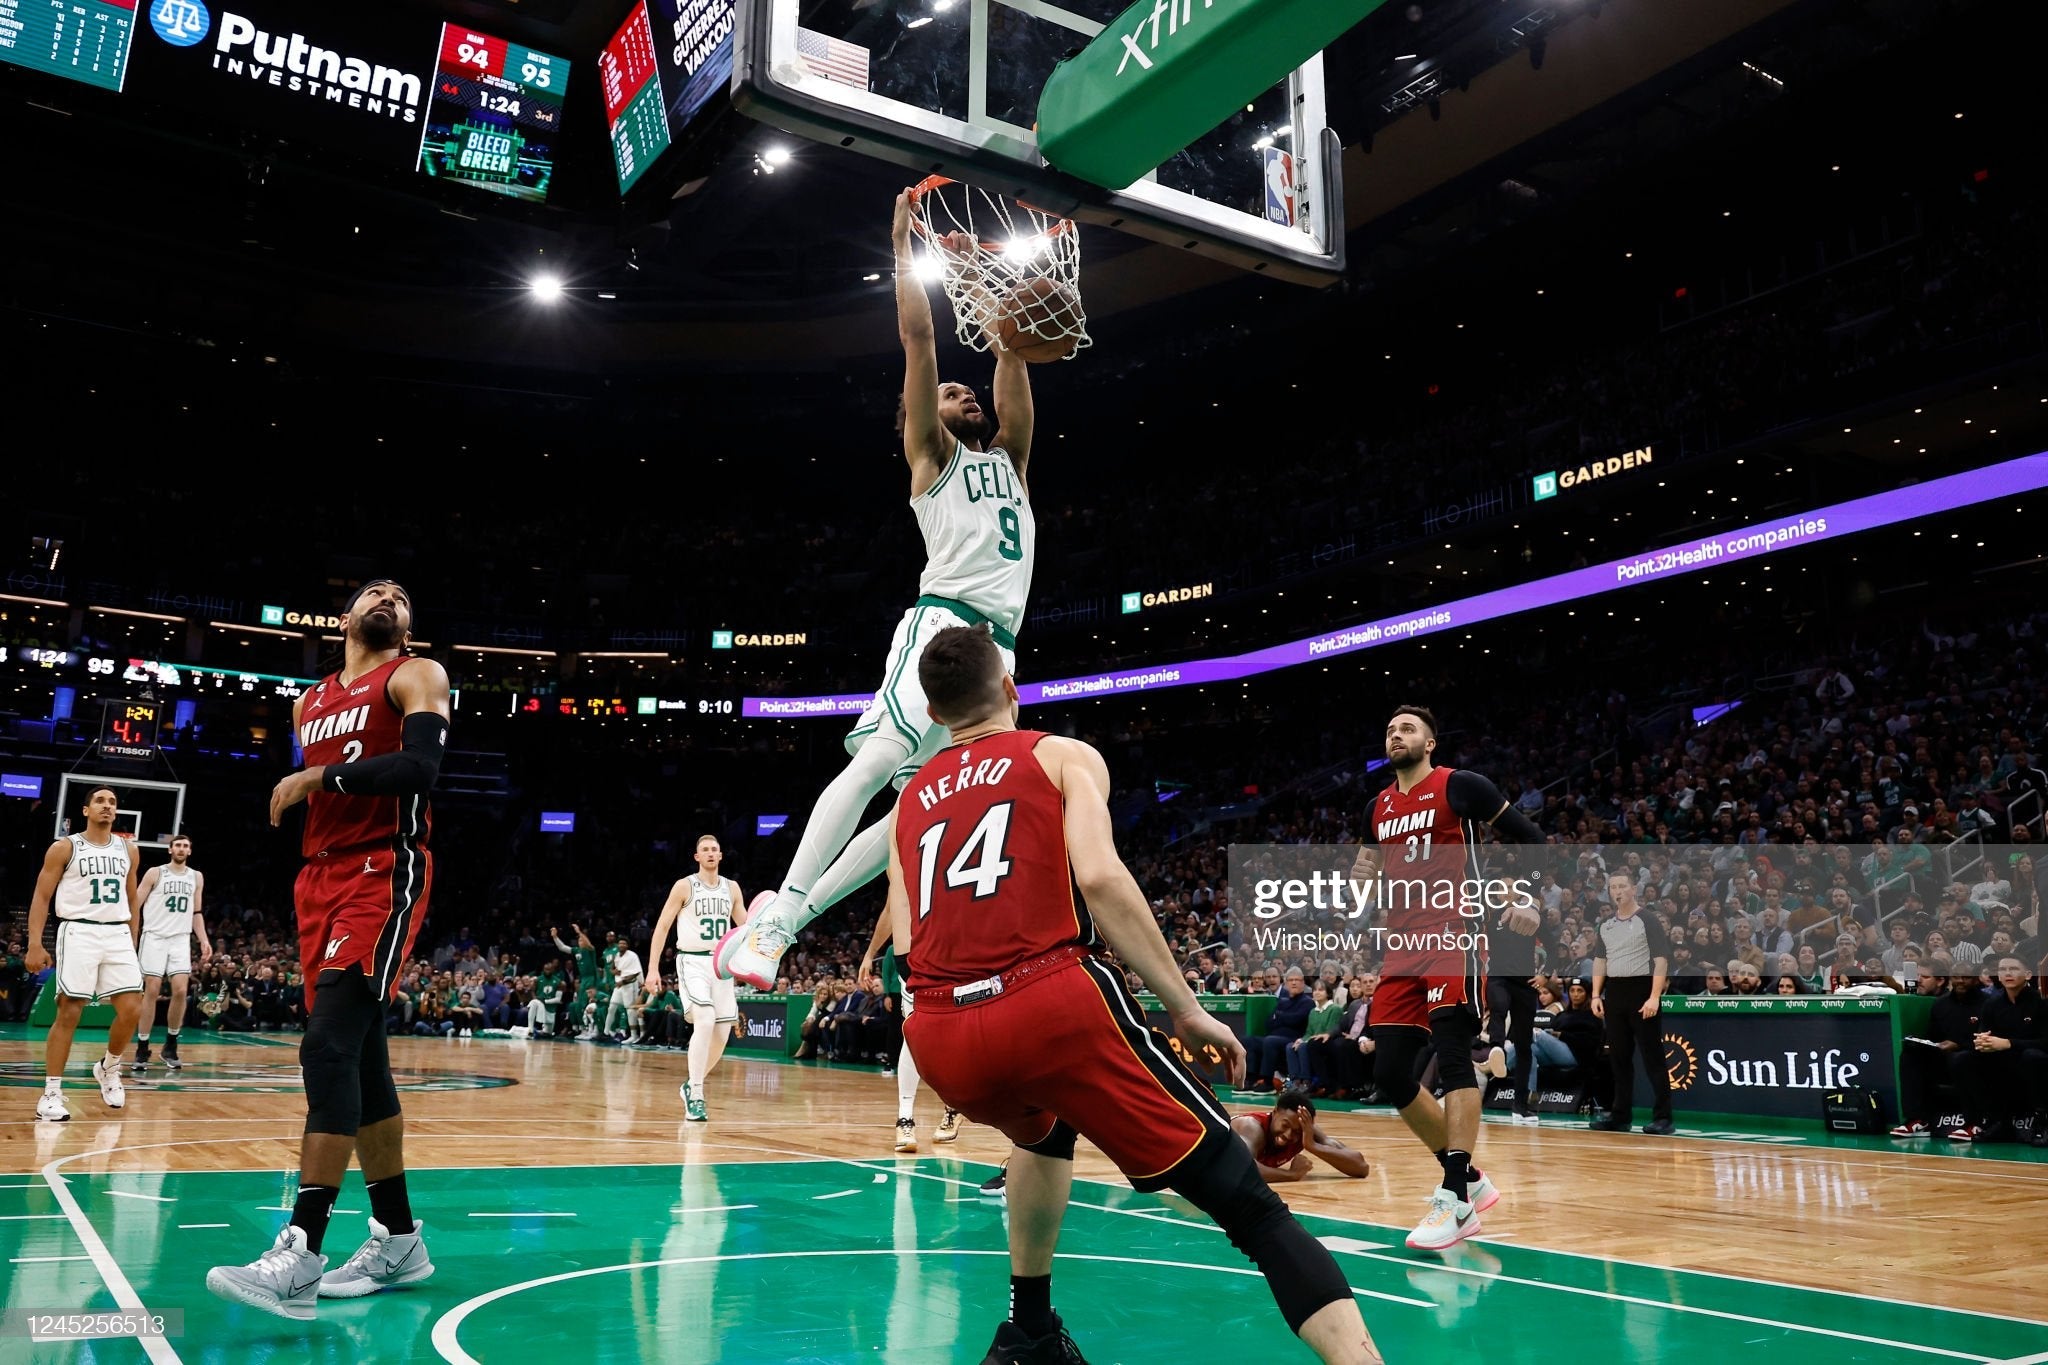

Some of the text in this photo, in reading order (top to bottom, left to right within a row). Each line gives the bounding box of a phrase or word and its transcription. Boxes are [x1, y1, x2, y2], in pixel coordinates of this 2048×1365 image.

[95, 13, 109, 21] AST
[98, 34, 104, 43] 3
[119, 30, 125, 39] 3
[51, 51, 57, 60] 2
[216, 11, 422, 106] Putnam
[457, 43, 489, 69] 94
[521, 63, 551, 88] 95
[212, 54, 417, 123] INVESTMENTS
[480, 91, 553, 123] 1:24 3rd
[467, 132, 511, 155] BLEED
[460, 150, 511, 173] GREEN
[1270, 205, 1285, 222] NBA
[1535, 446, 1653, 498] TD GARDEN
[998, 506, 1024, 562] 9
[1617, 518, 1827, 581] Point32Health companies
[1143, 583, 1214, 607] GARDEN
[734, 633, 807, 646] GARDEN
[1309, 611, 1452, 655] Point32Health companies
[30, 648, 67, 664] 1:24
[87, 657, 115, 675] 95
[1042, 669, 1180, 698] Point32Health companies
[126, 706, 154, 721] 1:24
[659, 700, 686, 709] Bank
[698, 699, 733, 714] 9:10
[759, 699, 836, 713] Point32Health
[116, 746, 152, 756] TISSOT
[342, 739, 363, 764] 2
[917, 757, 1013, 812] HERRO
[1377, 808, 1436, 842] MIAMI
[1404, 833, 1432, 863] 31
[79, 856, 128, 878] CELTICS
[917, 800, 1014, 922] 14
[89, 879, 121, 905] 13
[163, 880, 193, 896] CELTICS
[165, 896, 189, 913] 40
[695, 897, 730, 917] CELTICS
[700, 918, 727, 940] 30
[747, 1018, 782, 1038] Sun Life
[1707, 1049, 1860, 1090] Sun Life
[1538, 1091, 1574, 1104] jetBlue
